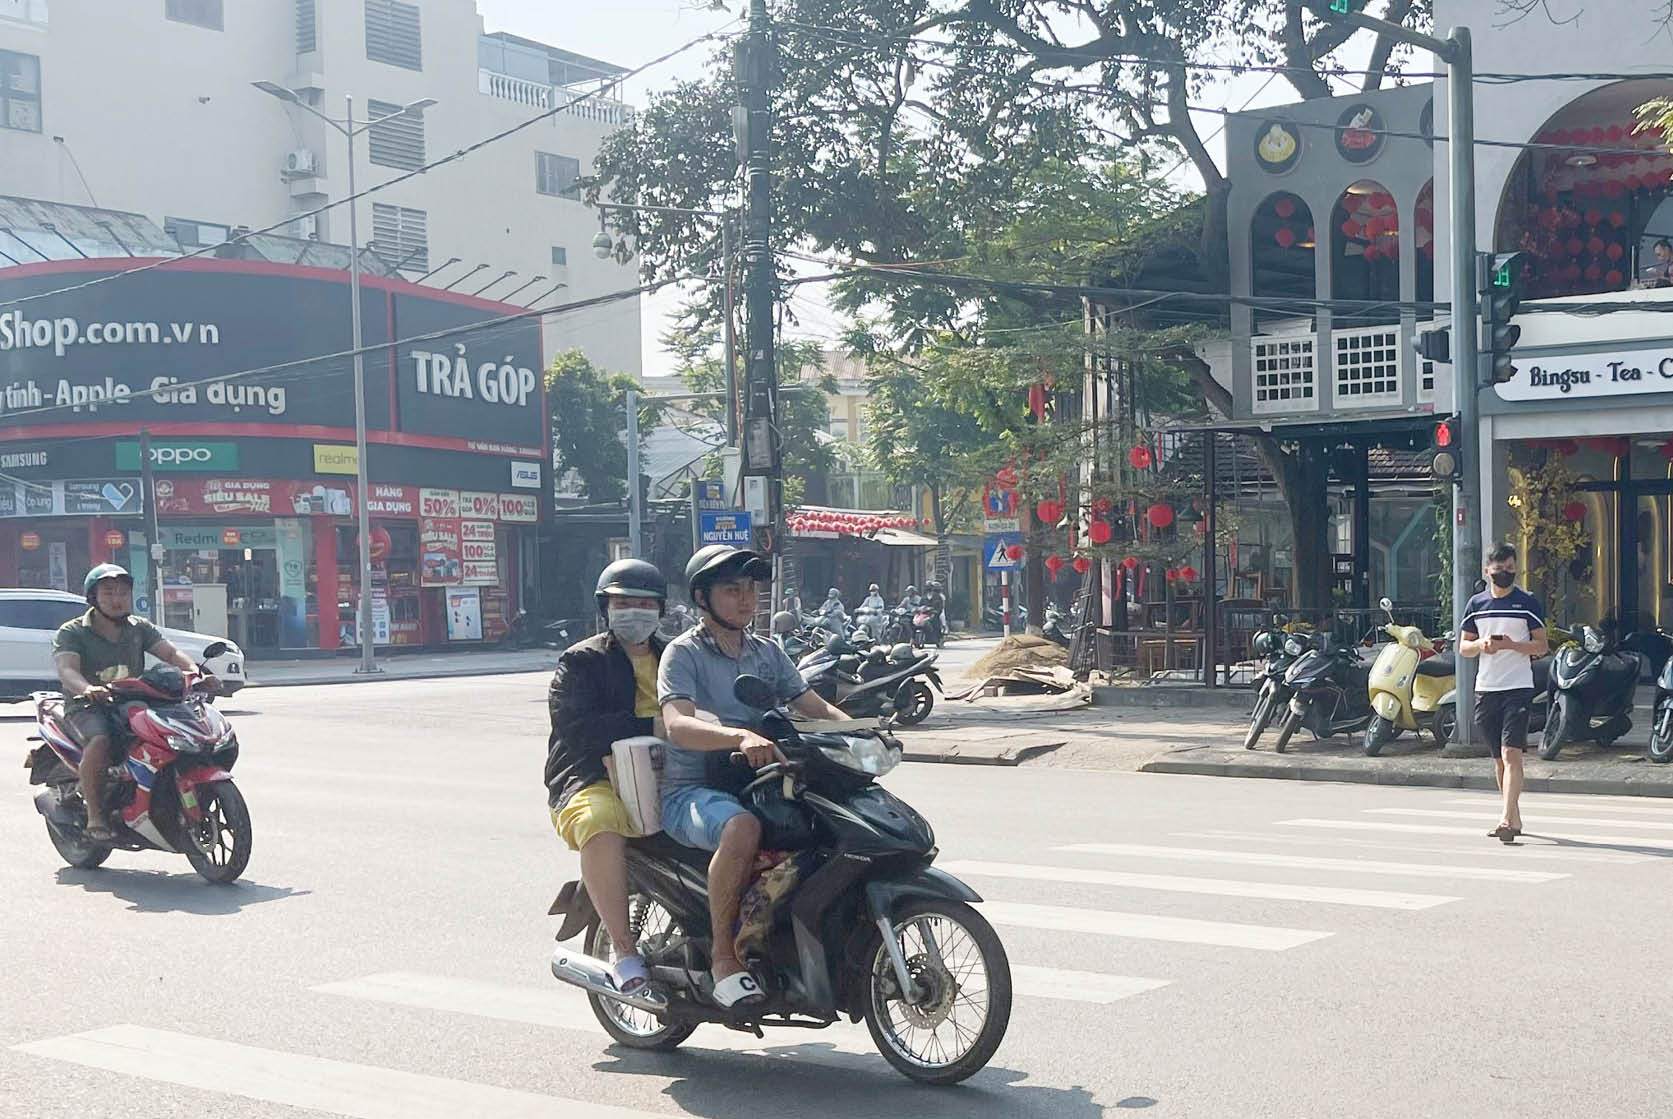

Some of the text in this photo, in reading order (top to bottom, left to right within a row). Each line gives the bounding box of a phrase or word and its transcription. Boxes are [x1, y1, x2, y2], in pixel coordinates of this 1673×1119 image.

[410, 343, 535, 406] TRẢ GÓP
[1529, 366, 1591, 393] Bingsu
[1606, 361, 1641, 382] Tea
[152, 376, 197, 404] Gia
[207, 381, 286, 414] dụng
[1, 452, 48, 468] SAMSUNG
[368, 501, 384, 512] GIA
[423, 497, 457, 514] 50%
[473, 497, 496, 515] 0%
[175, 532, 218, 545] Redmi
[463, 525, 477, 537] 24
[464, 545, 483, 558] 100
